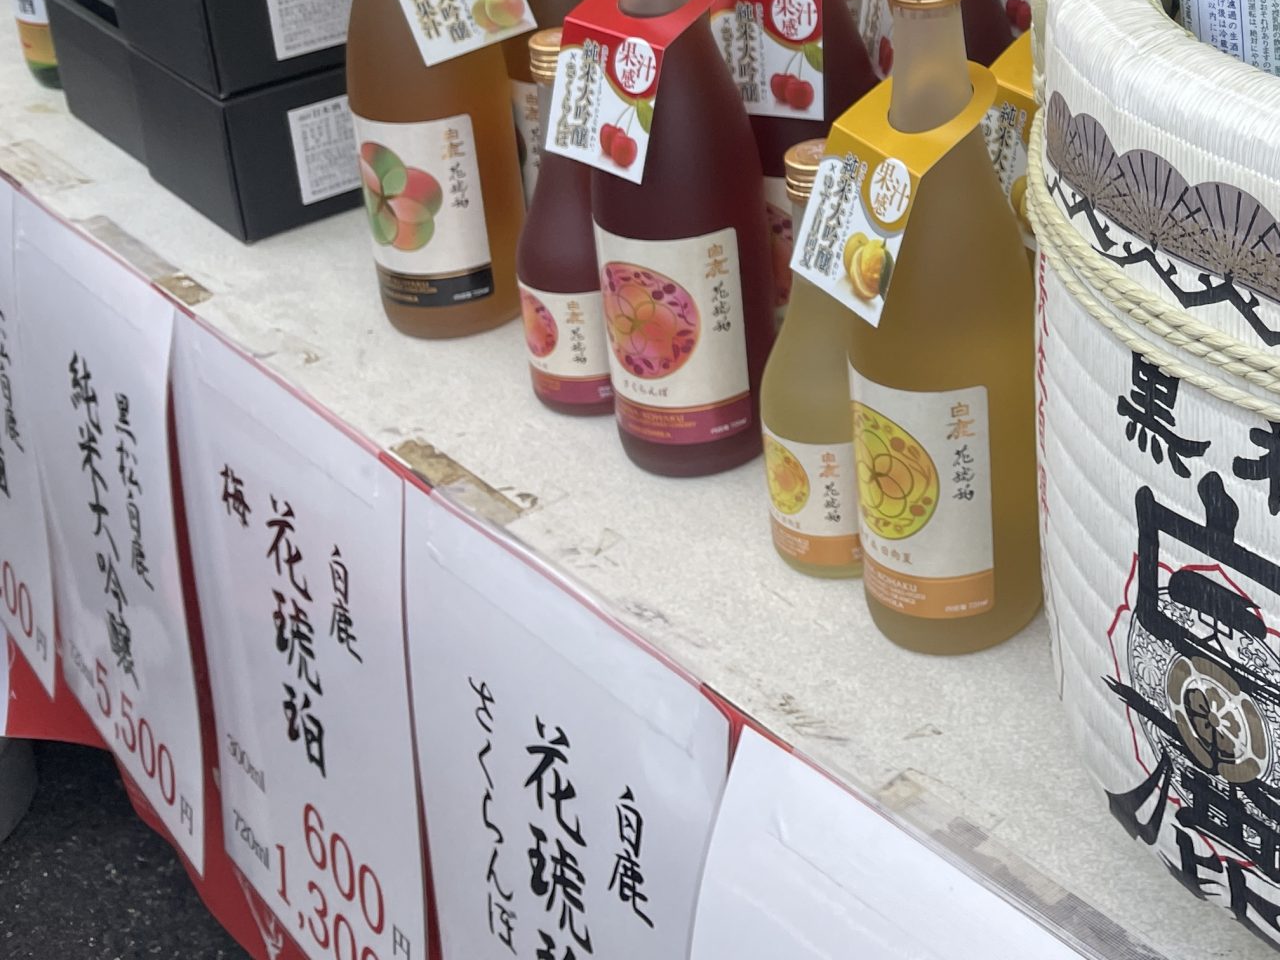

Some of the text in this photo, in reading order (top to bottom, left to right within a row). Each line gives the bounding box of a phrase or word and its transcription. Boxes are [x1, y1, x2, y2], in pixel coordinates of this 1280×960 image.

[68, 351, 140, 691] 純米大吟醸
[220, 463, 252, 528] 梅
[266, 494, 327, 778] 花琥珀
[329, 544, 363, 664] 白鹿
[276, 843, 384, 960] 1,30
[608, 785, 654, 929] 白鹿
